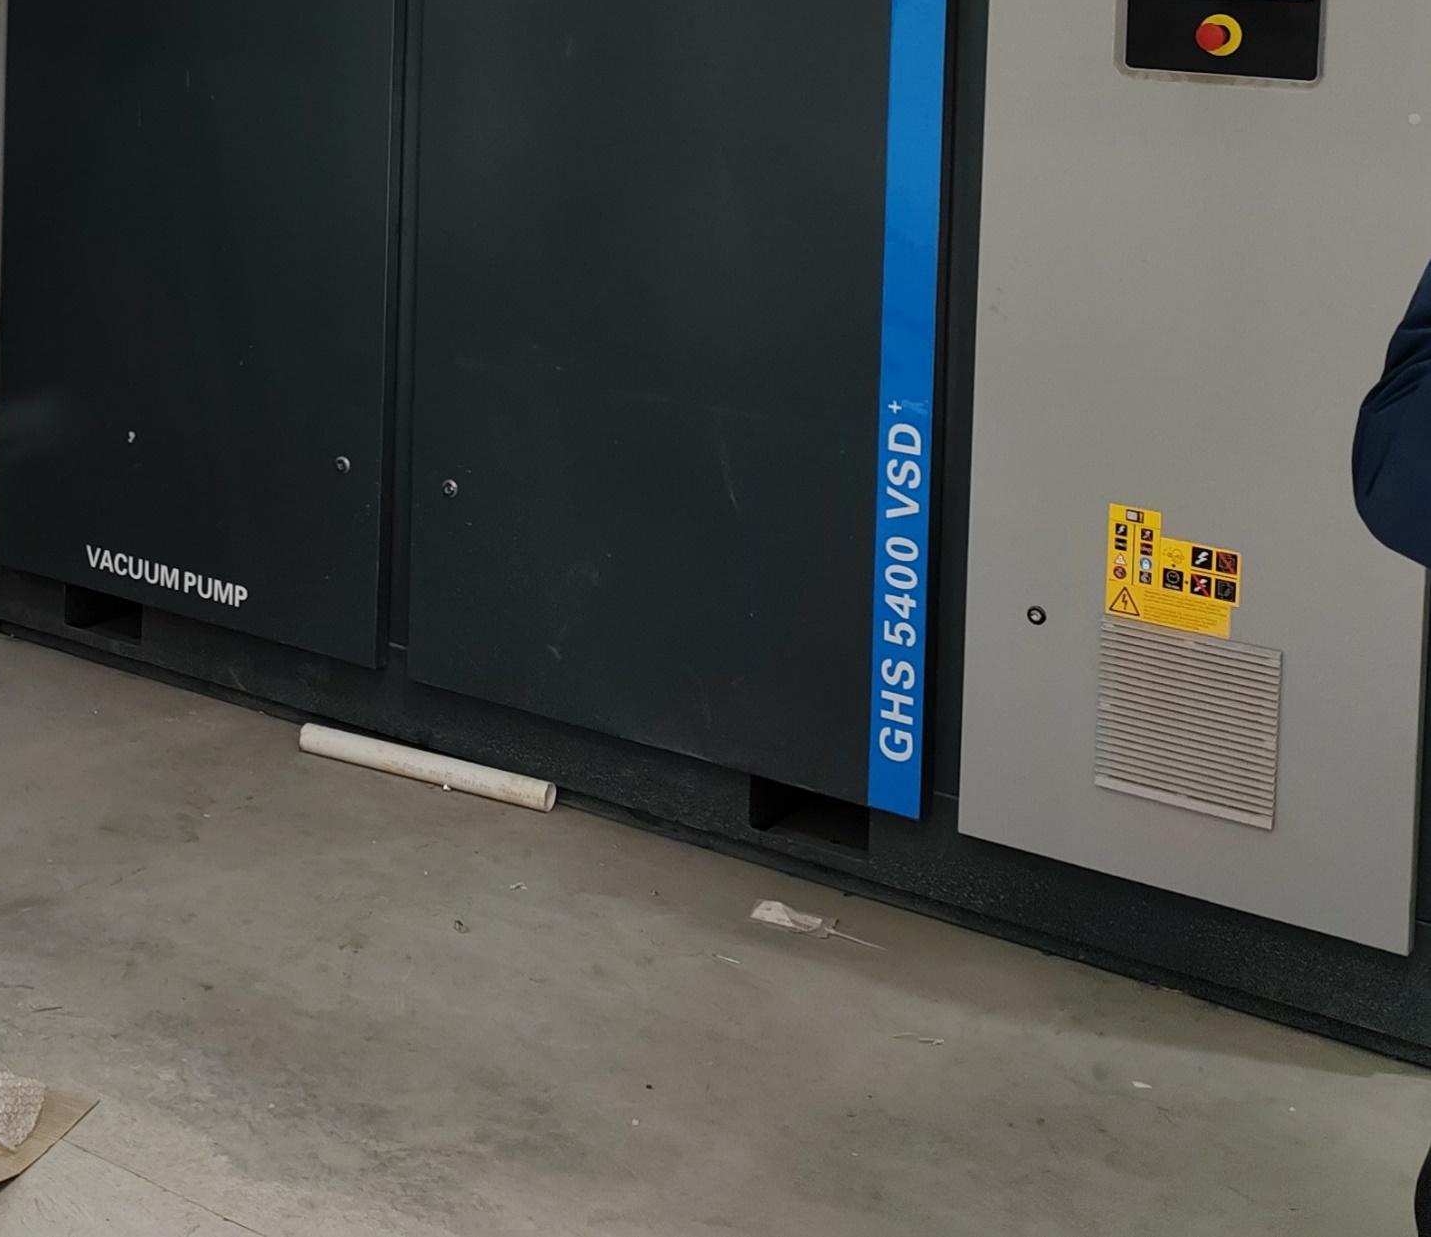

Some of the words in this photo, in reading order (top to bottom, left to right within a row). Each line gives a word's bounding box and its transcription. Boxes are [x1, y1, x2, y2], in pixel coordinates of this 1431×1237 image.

[85, 544, 180, 591] VACUUM
[183, 571, 249, 608] PUMP
[884, 536, 919, 647] 5400
[879, 658, 915, 763] GHS
